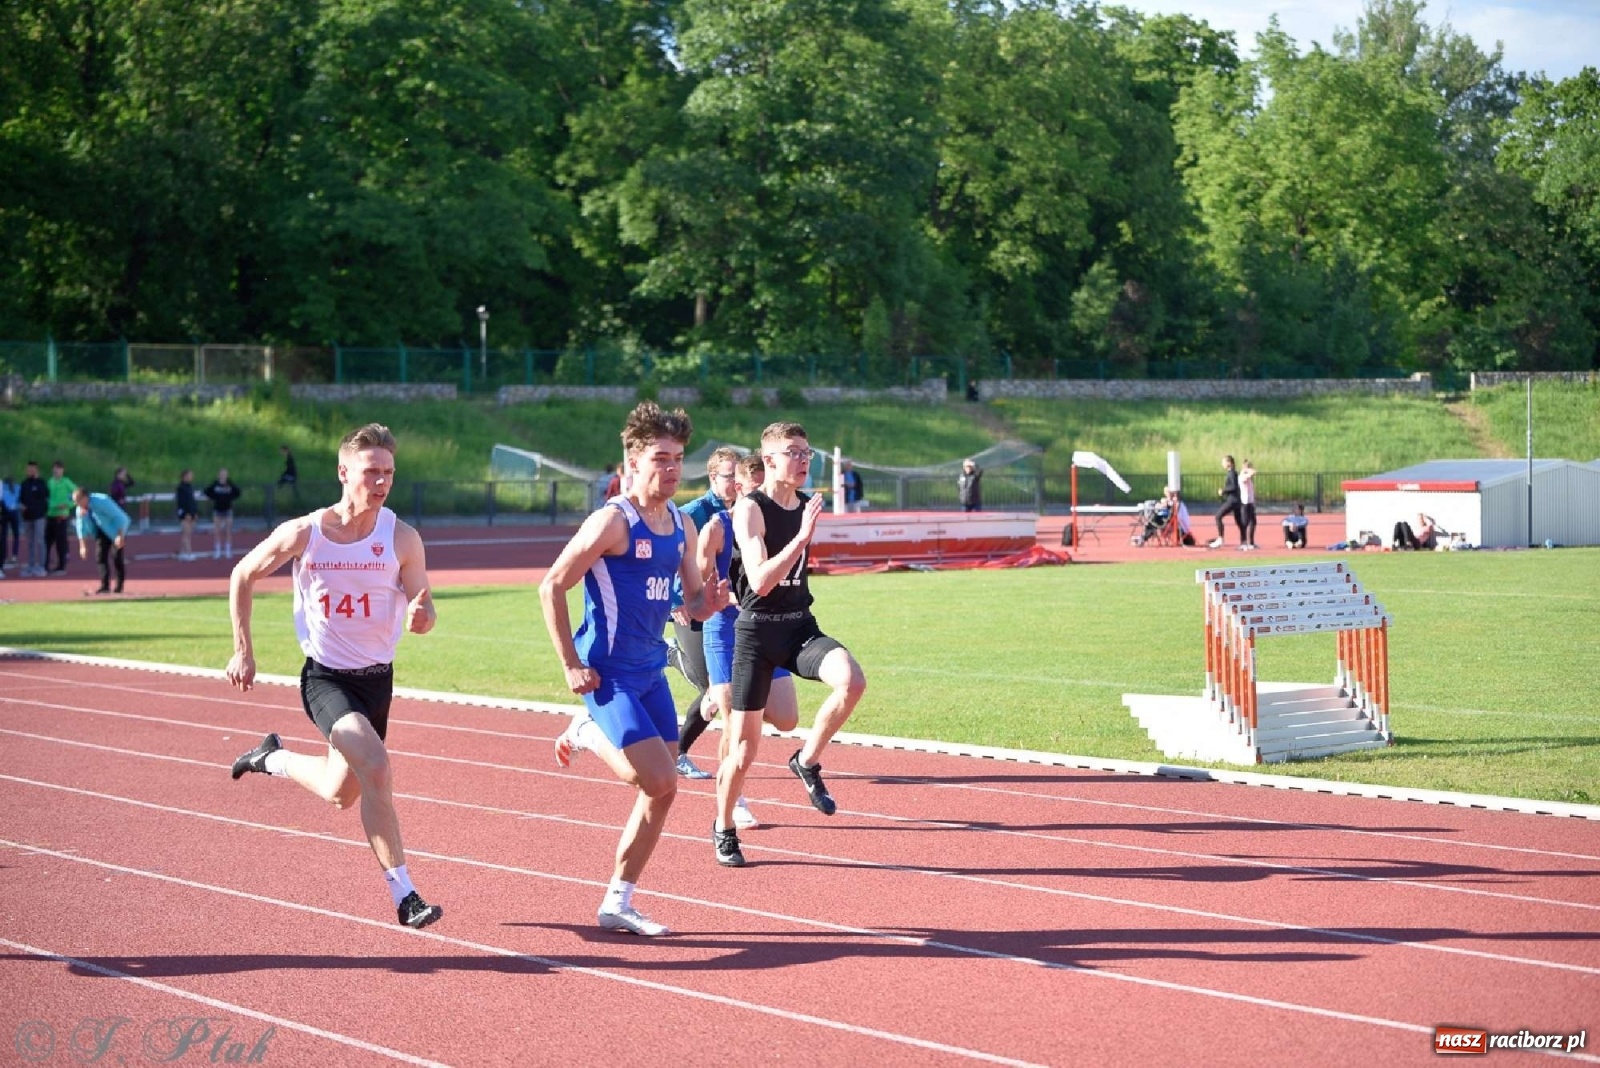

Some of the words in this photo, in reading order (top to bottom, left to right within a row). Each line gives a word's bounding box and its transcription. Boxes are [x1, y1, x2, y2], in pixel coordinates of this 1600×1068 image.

[646, 576, 670, 601] 303
[318, 592, 371, 619] 141
[750, 612, 781, 622] NIKE
[782, 611, 804, 622] PRO
